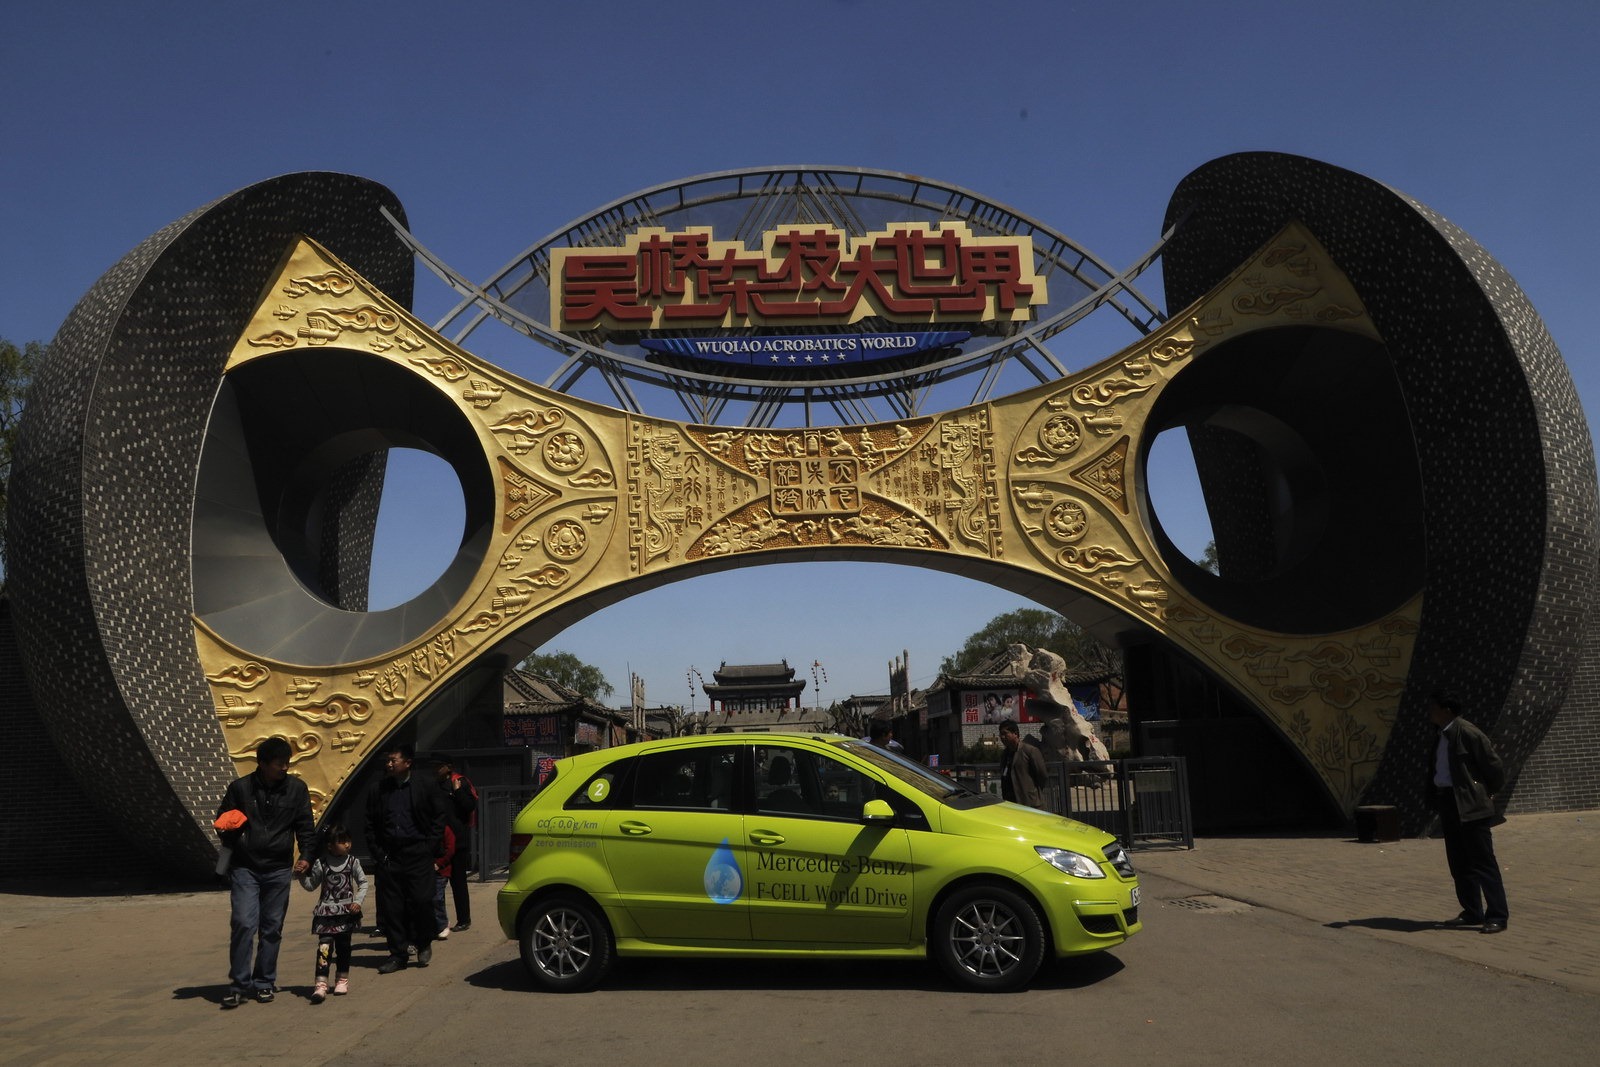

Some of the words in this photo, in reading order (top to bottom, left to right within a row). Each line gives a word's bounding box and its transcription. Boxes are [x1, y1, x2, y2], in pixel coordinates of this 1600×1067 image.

[564, 229, 1034, 321] 吴桥杂技大世界
[696, 340, 761, 355] WUQIAO
[762, 338, 857, 353] ACROBATICS
[860, 336, 917, 350] WORLD
[594, 783, 605, 797] 2
[536, 839, 554, 847] zero
[557, 839, 597, 849] emission
[756, 851, 907, 876] Mercedes-Benz
[757, 882, 810, 902] F-CELL
[815, 885, 859, 905] World
[865, 887, 907, 907] Drive
